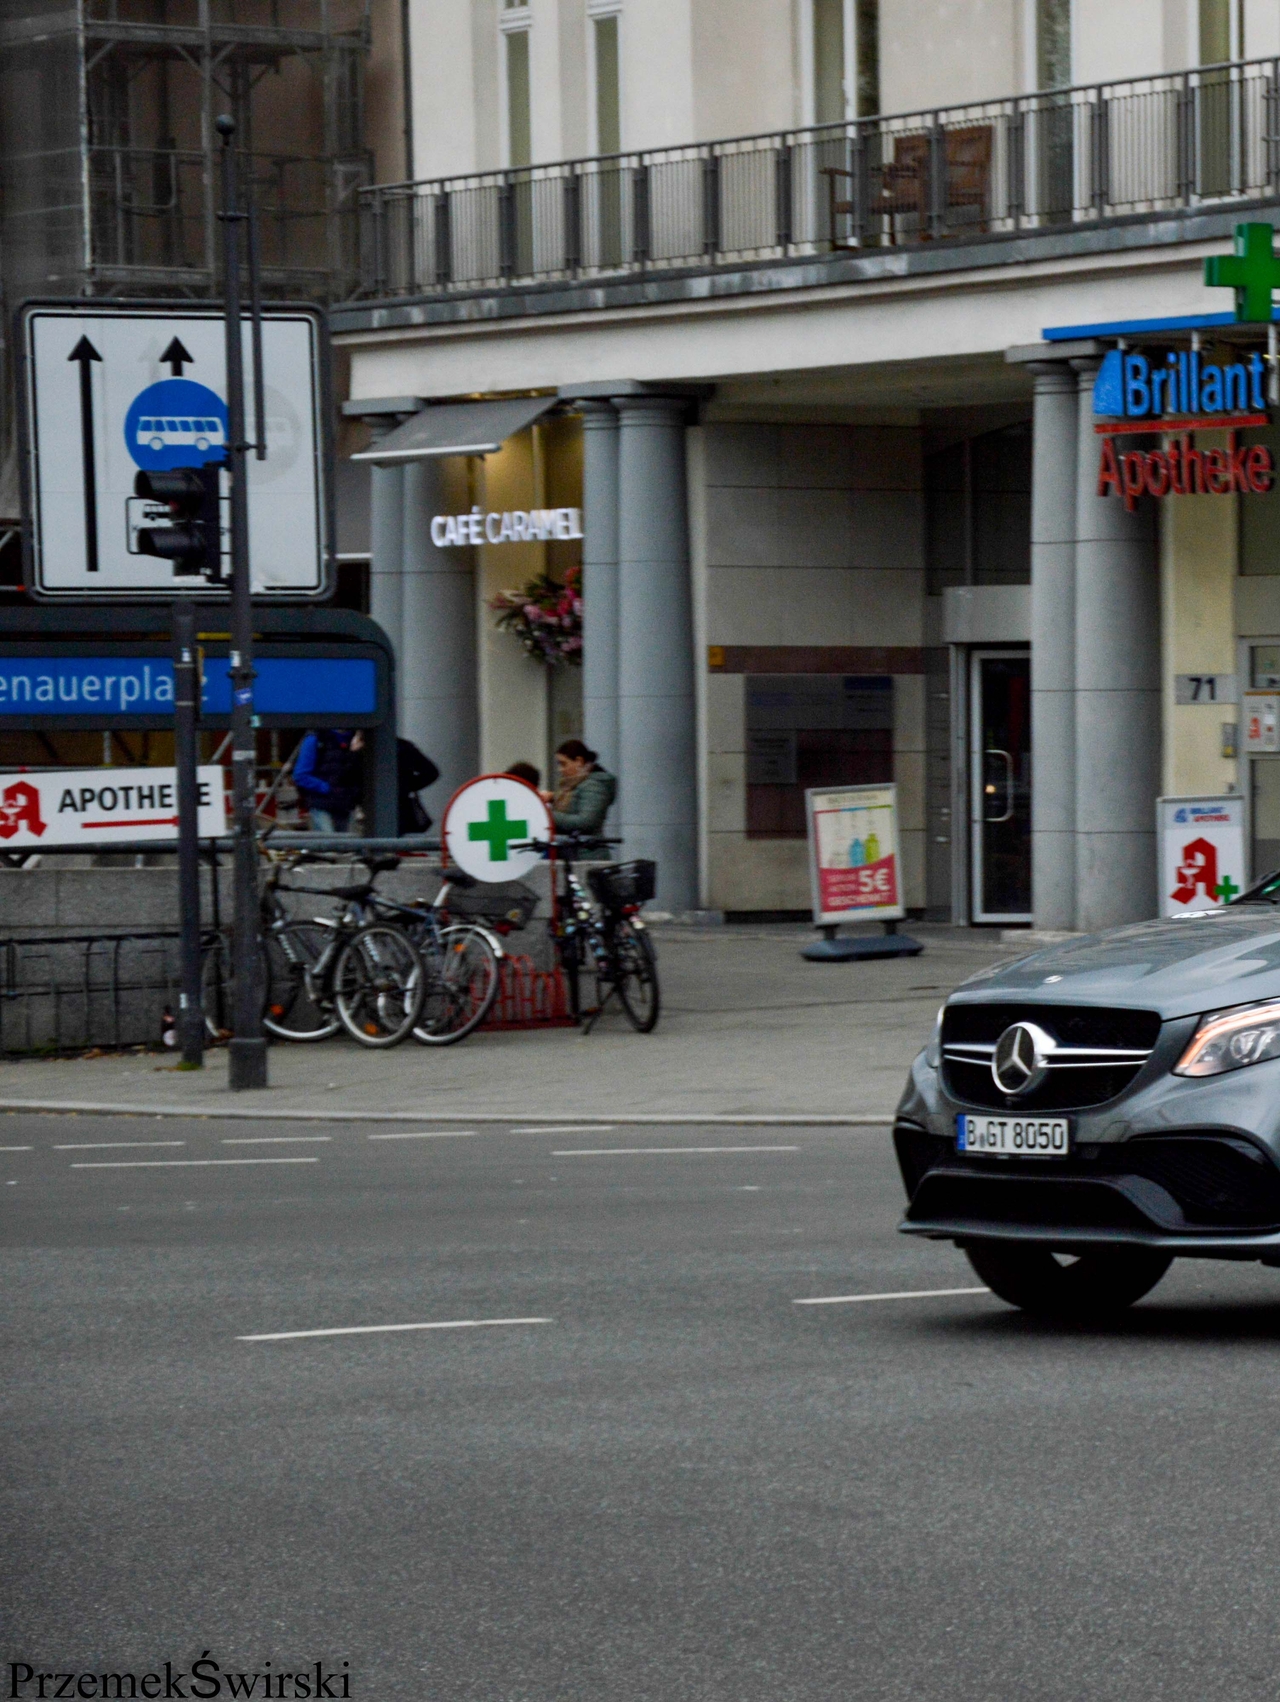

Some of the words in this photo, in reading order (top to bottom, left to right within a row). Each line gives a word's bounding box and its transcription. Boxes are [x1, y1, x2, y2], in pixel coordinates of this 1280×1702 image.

[1124, 352, 1266, 416] Brillant
[1097, 431, 1271, 512] Apotheke
[431, 505, 485, 547] CAFÉ
[486, 507, 584, 544] CARAMEL
[0, 664, 208, 711] nauerplaz
[1189, 681, 1215, 701] 71
[58, 782, 211, 813] APOTHEE
[858, 867, 892, 893] 5€
[967, 1120, 976, 1146] B
[987, 1121, 1008, 1148] GT
[1014, 1122, 1064, 1149] 8050
